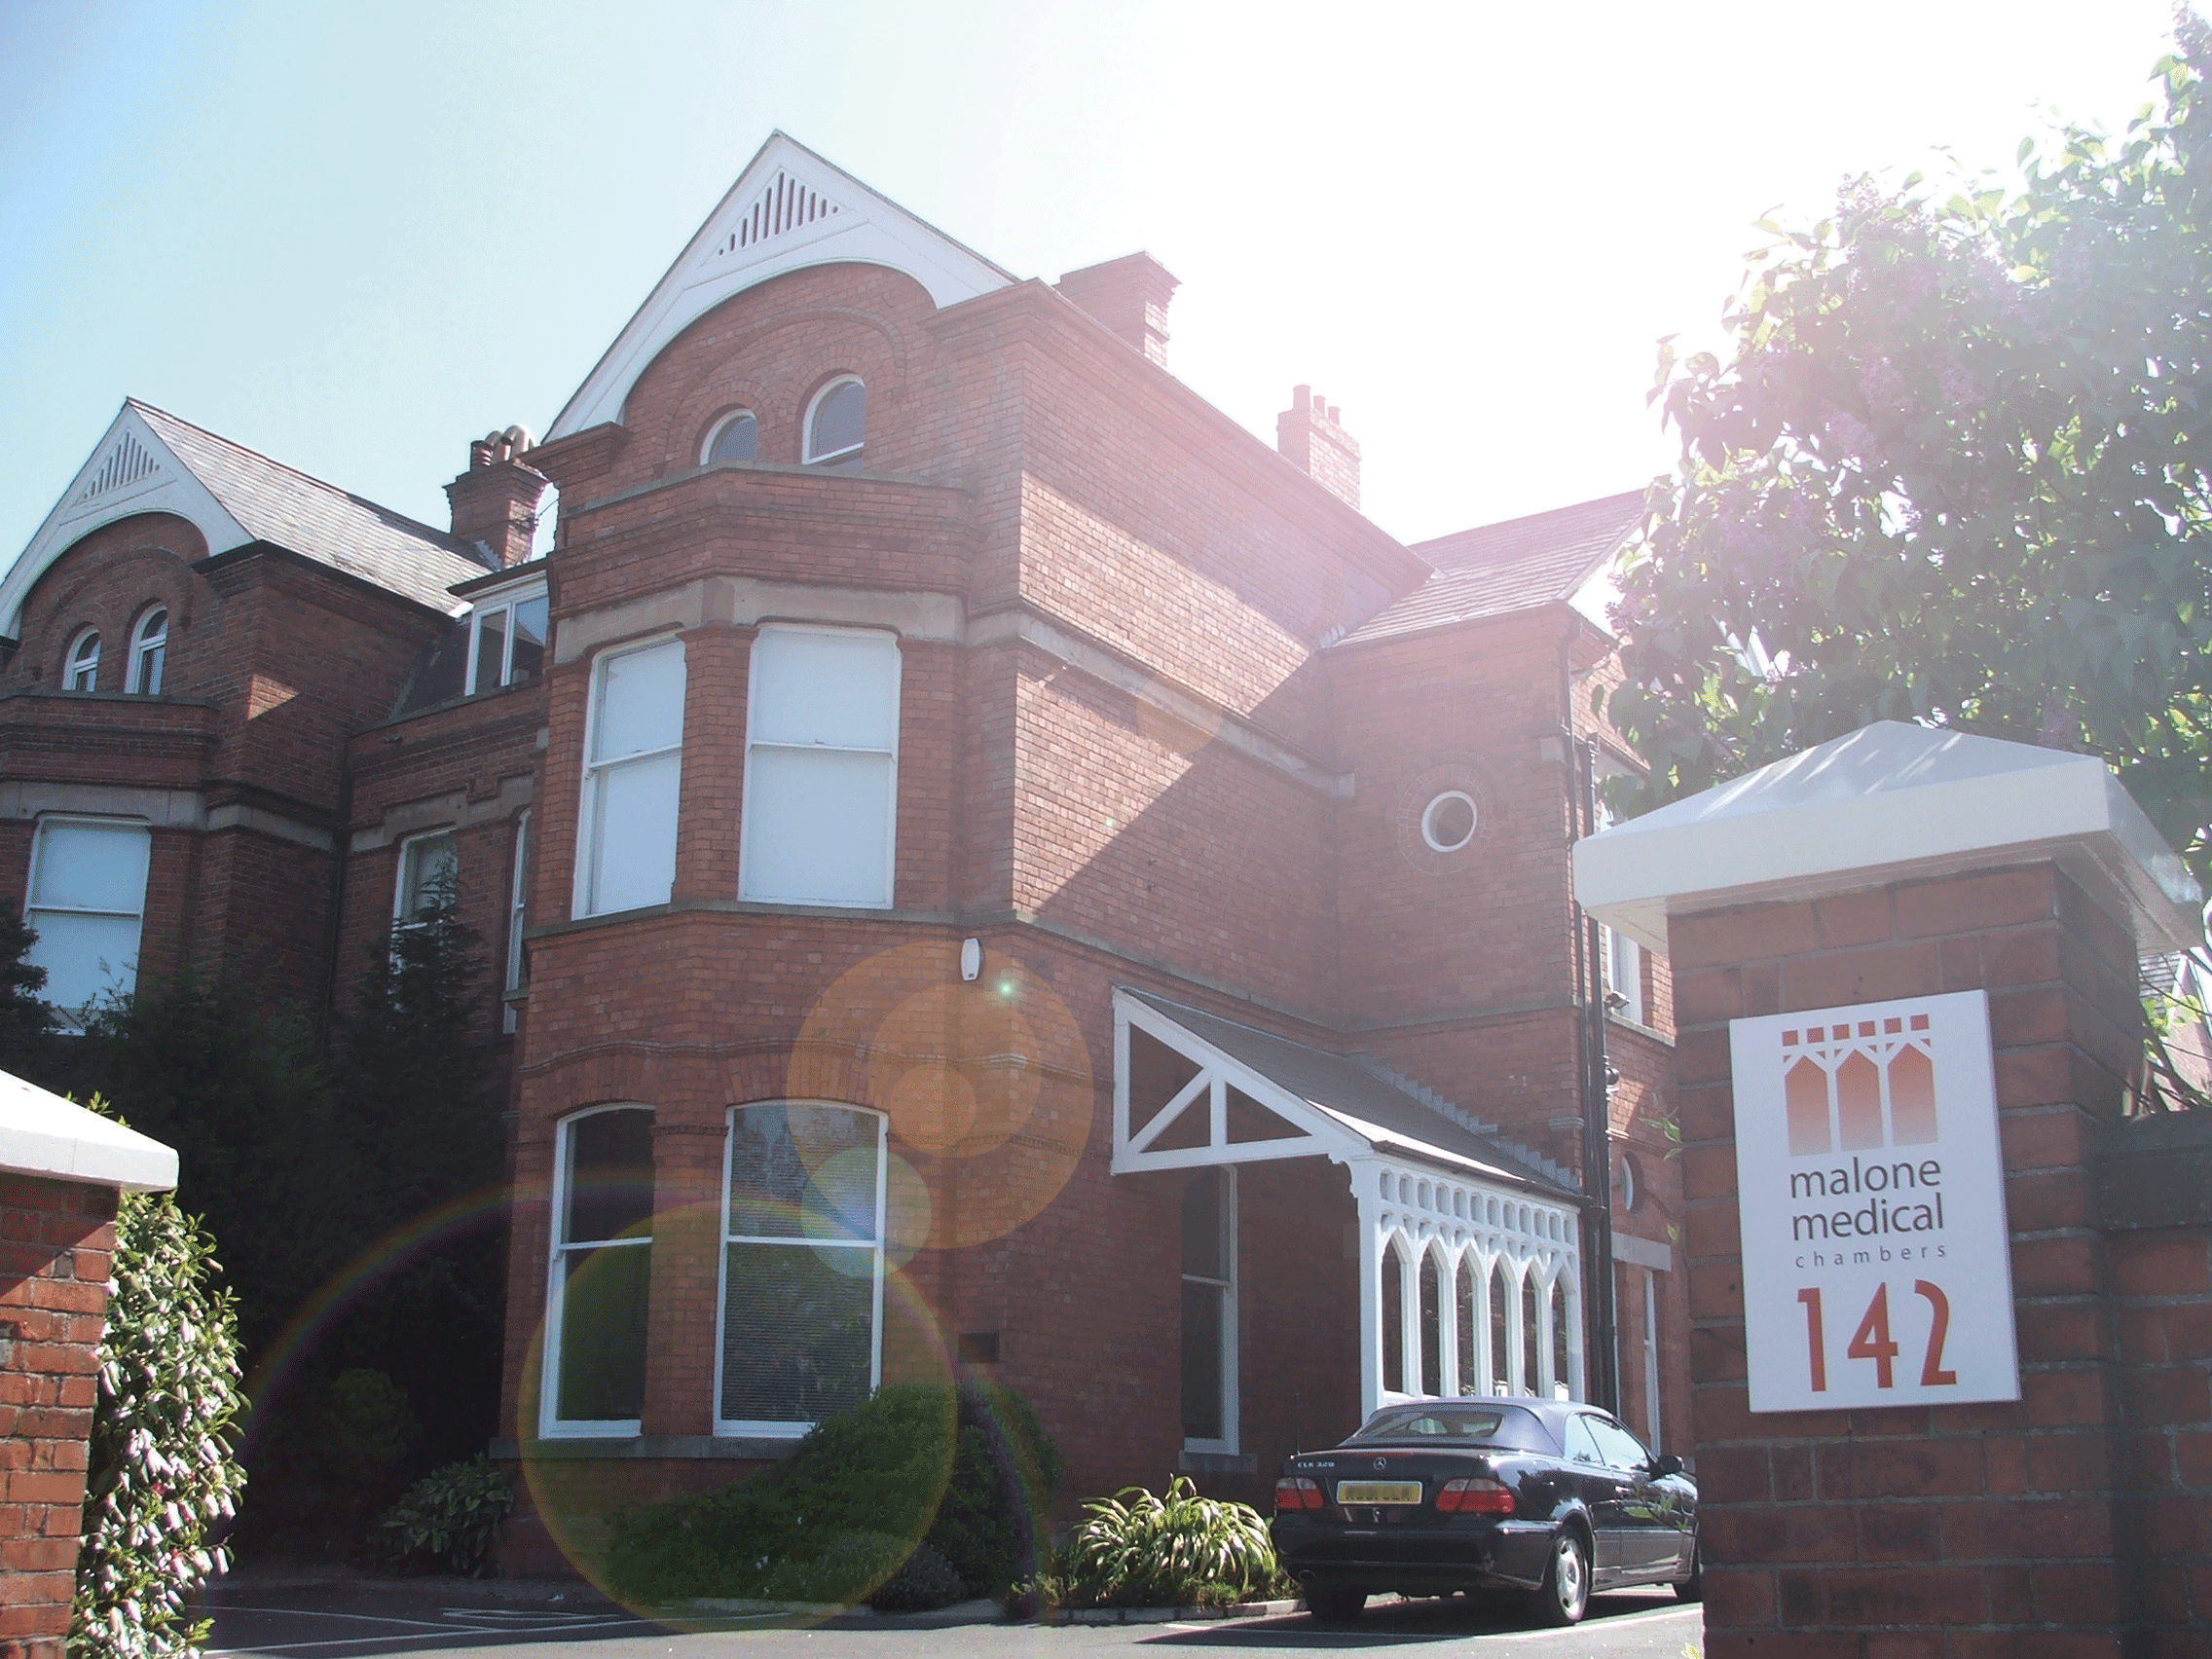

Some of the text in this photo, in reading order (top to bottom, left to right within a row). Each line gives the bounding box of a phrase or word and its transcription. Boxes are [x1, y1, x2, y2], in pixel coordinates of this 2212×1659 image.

[1790, 1157, 1941, 1198] malone
[1792, 1193, 1944, 1241] medical
[1795, 1244, 1945, 1269] chambers
[1797, 1279, 1957, 1392] 142
